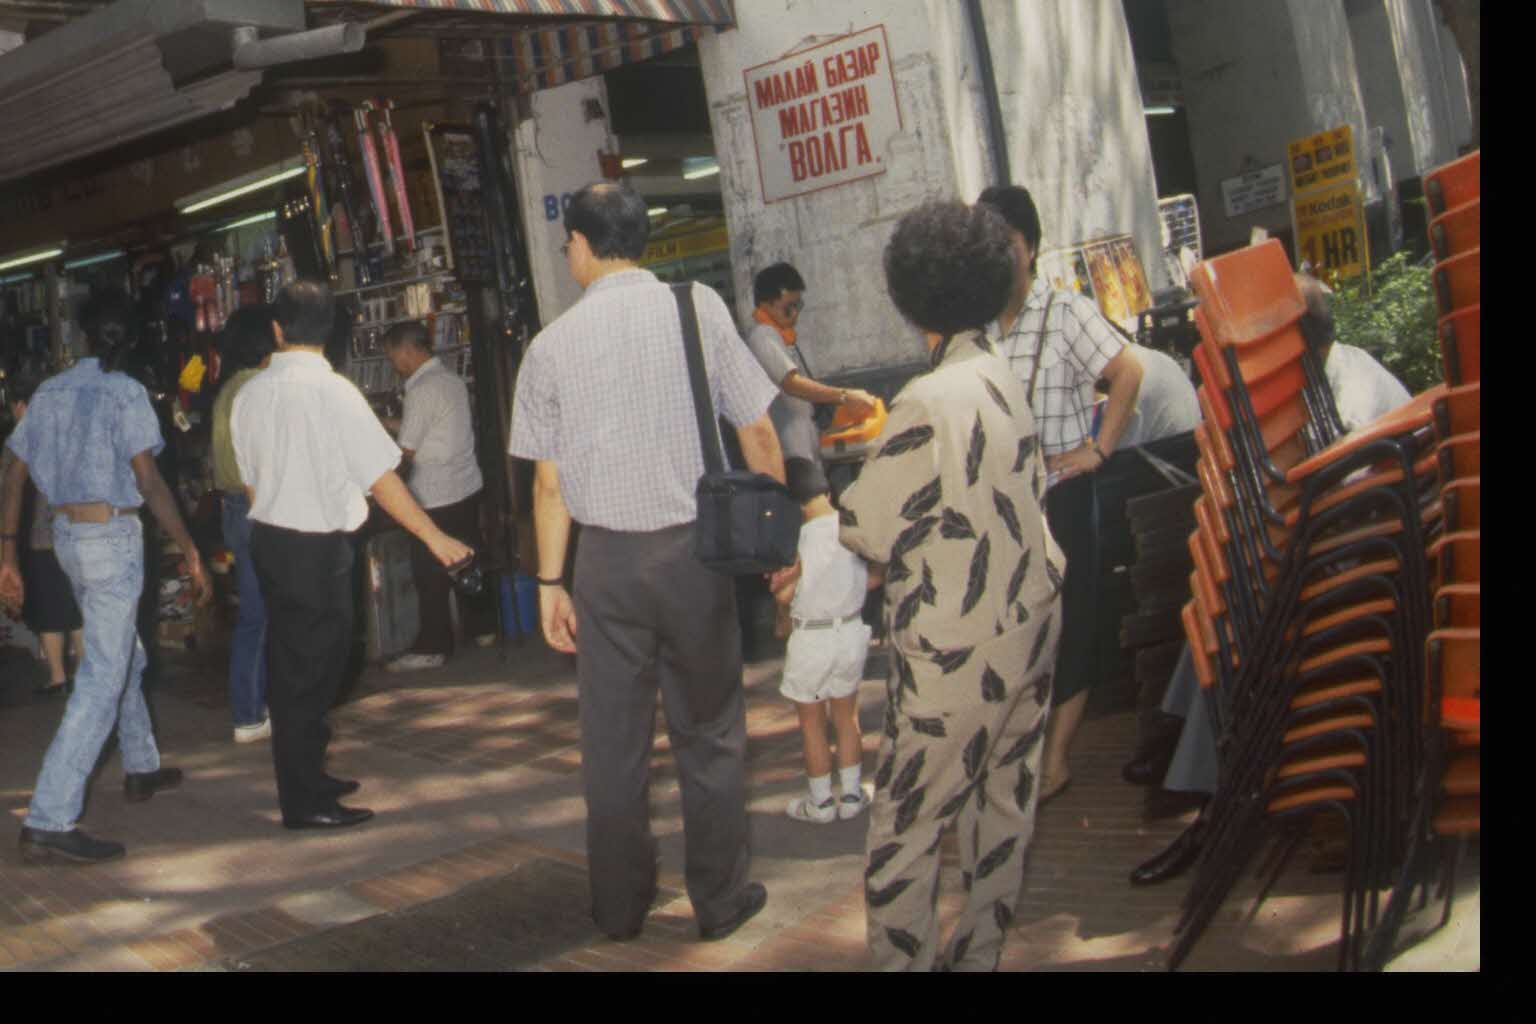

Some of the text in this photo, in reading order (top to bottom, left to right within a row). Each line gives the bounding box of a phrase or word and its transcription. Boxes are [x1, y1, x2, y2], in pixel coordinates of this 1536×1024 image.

[754, 41, 880, 110] МАЛАЙ БАЗАР
[778, 84, 870, 139] МАГАЗИН
[1322, 226, 1359, 269] HR
